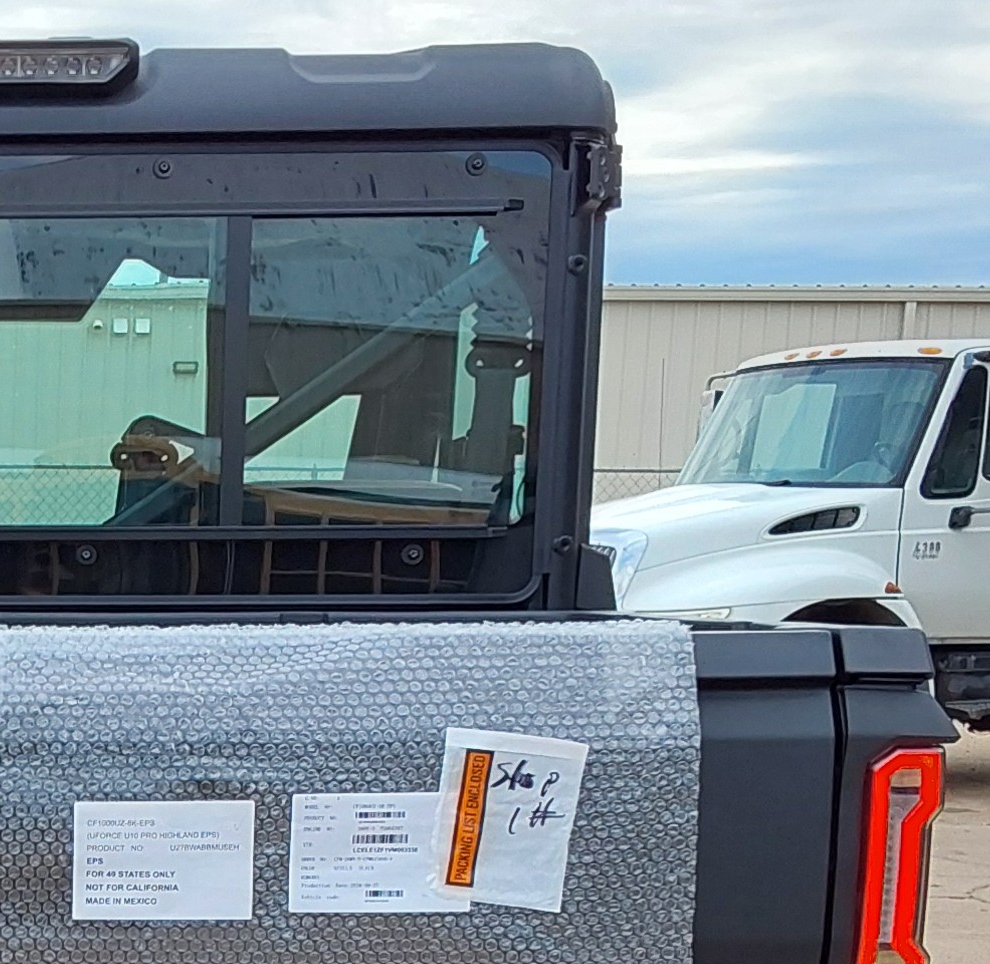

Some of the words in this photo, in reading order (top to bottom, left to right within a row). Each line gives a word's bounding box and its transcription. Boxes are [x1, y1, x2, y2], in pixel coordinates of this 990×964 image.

[467, 754, 486, 808] ENCLOSED
[463, 810, 478, 837] LIST
[159, 831, 199, 839] HIGHLAND
[200, 831, 220, 839] EPS)
[86, 844, 125, 852] PRODUCT
[86, 857, 104, 865] EPS
[454, 837, 473, 882] PACKING
[86, 870, 104, 878] FOR
[117, 870, 151, 878] STATES
[152, 870, 176, 878] ONLY
[86, 883, 103, 891] NOT
[106, 883, 124, 891] FOR
[126, 883, 179, 891] CALIFORNIA
[85, 897, 110, 905] MADE
[112, 897, 121, 905] IN
[123, 897, 157, 905] MEXICO
